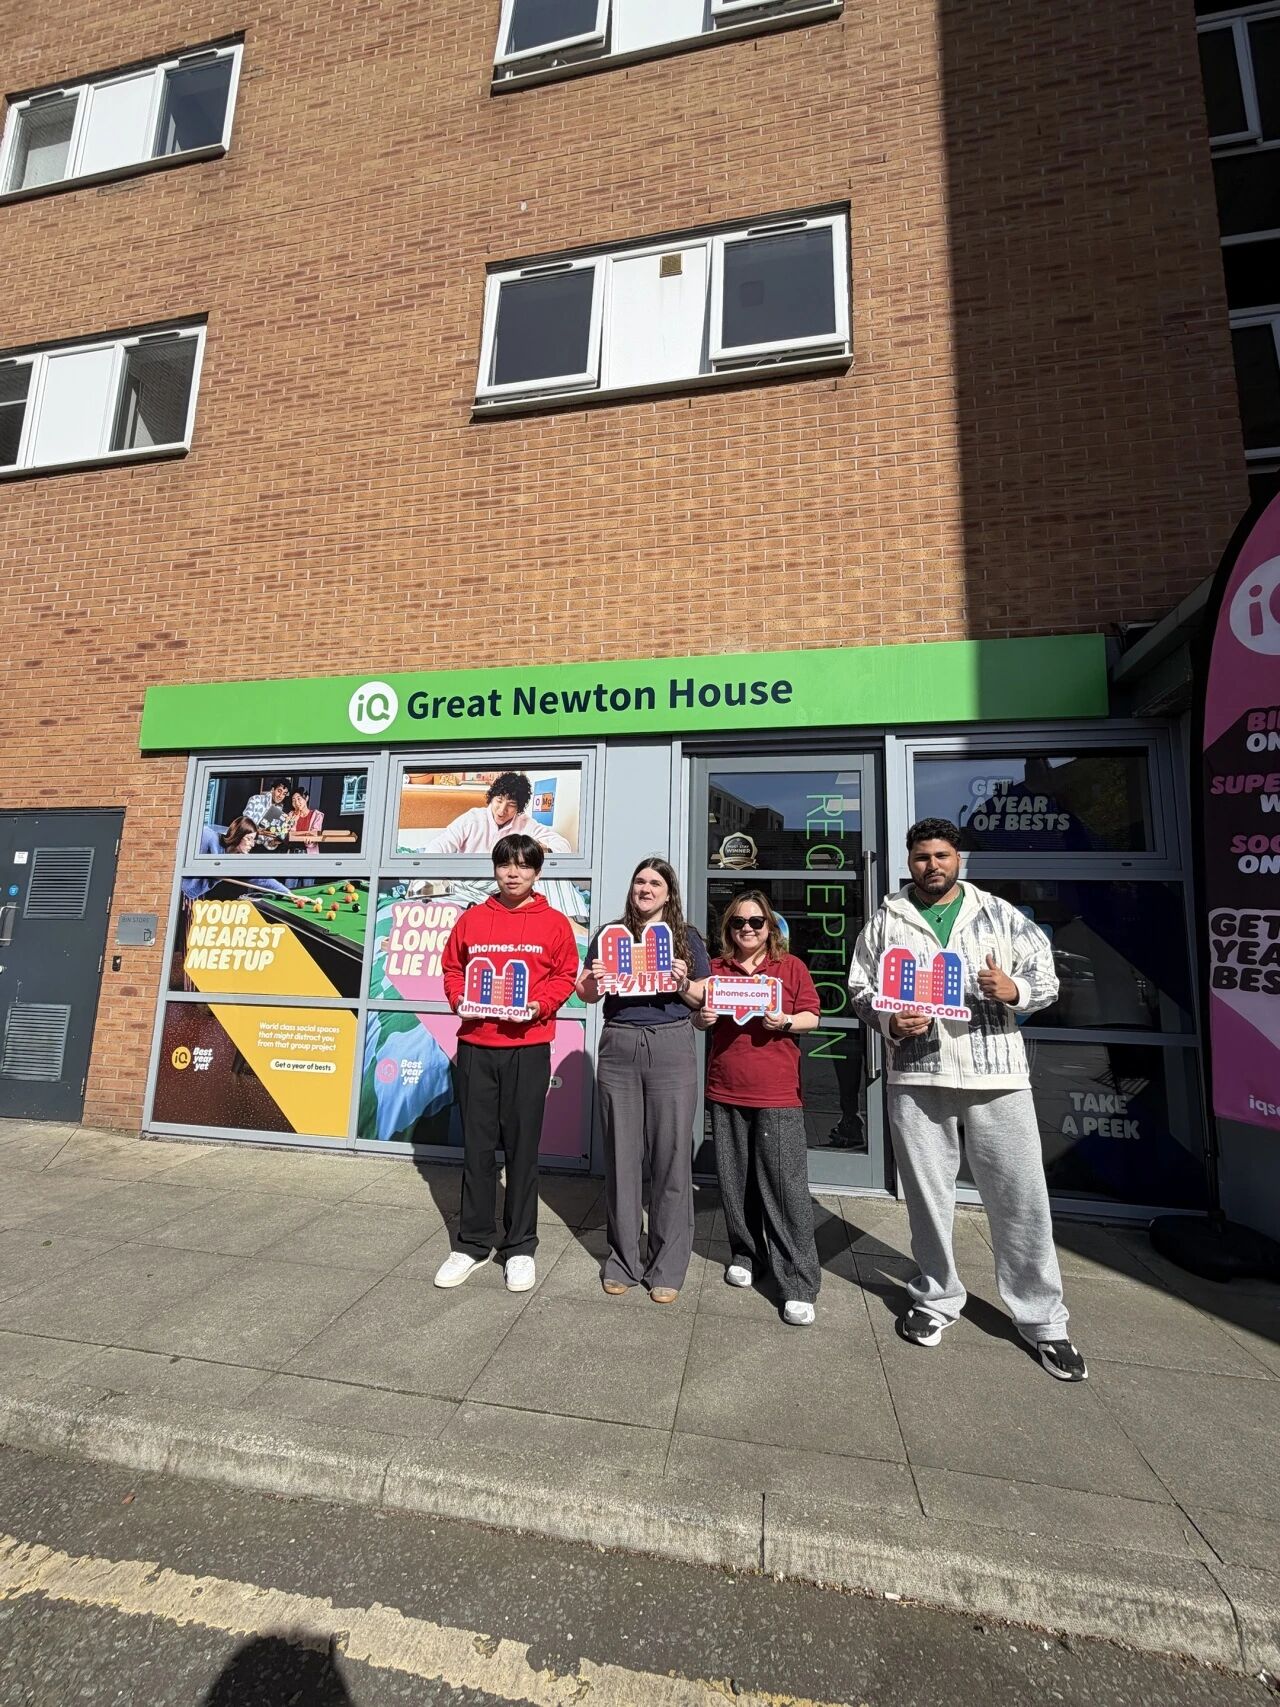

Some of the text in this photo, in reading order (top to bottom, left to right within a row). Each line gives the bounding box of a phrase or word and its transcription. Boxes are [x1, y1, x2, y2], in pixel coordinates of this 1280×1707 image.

[356, 677, 794, 722] iQ Great Newton House
[1247, 710, 1280, 732] BI
[971, 778, 1013, 796] GET
[974, 796, 1048, 813] A YEAR
[973, 813, 1071, 831] OF BESTS
[195, 903, 251, 925] YOUR
[394, 905, 458, 929] YOUR
[805, 794, 848, 1060] RECEPTION
[189, 926, 286, 949] NEAREST
[468, 944, 543, 954] uhomes.com
[187, 948, 275, 971] MEETUP
[388, 952, 425, 976] LIE
[715, 989, 770, 998] uhomes.com
[461, 1003, 531, 1017] uhomes.com
[875, 999, 970, 1019] uhomes.com
[259, 1022, 340, 1034] World class social spaces
[257, 1039, 274, 1047] from
[290, 1043, 311, 1051] group
[311, 1044, 336, 1052] project
[273, 1033, 294, 1041] might
[294, 1033, 321, 1041] distract
[175, 1051, 188, 1064] iQ
[193, 1047, 213, 1055] Best
[193, 1055, 214, 1064] year
[194, 1062, 209, 1071] yet
[401, 1059, 422, 1069] Best
[401, 1068, 424, 1077] year
[403, 1076, 419, 1085] yet
[1069, 1092, 1128, 1115] TAKE
[1062, 1115, 1141, 1140] A PEEK
